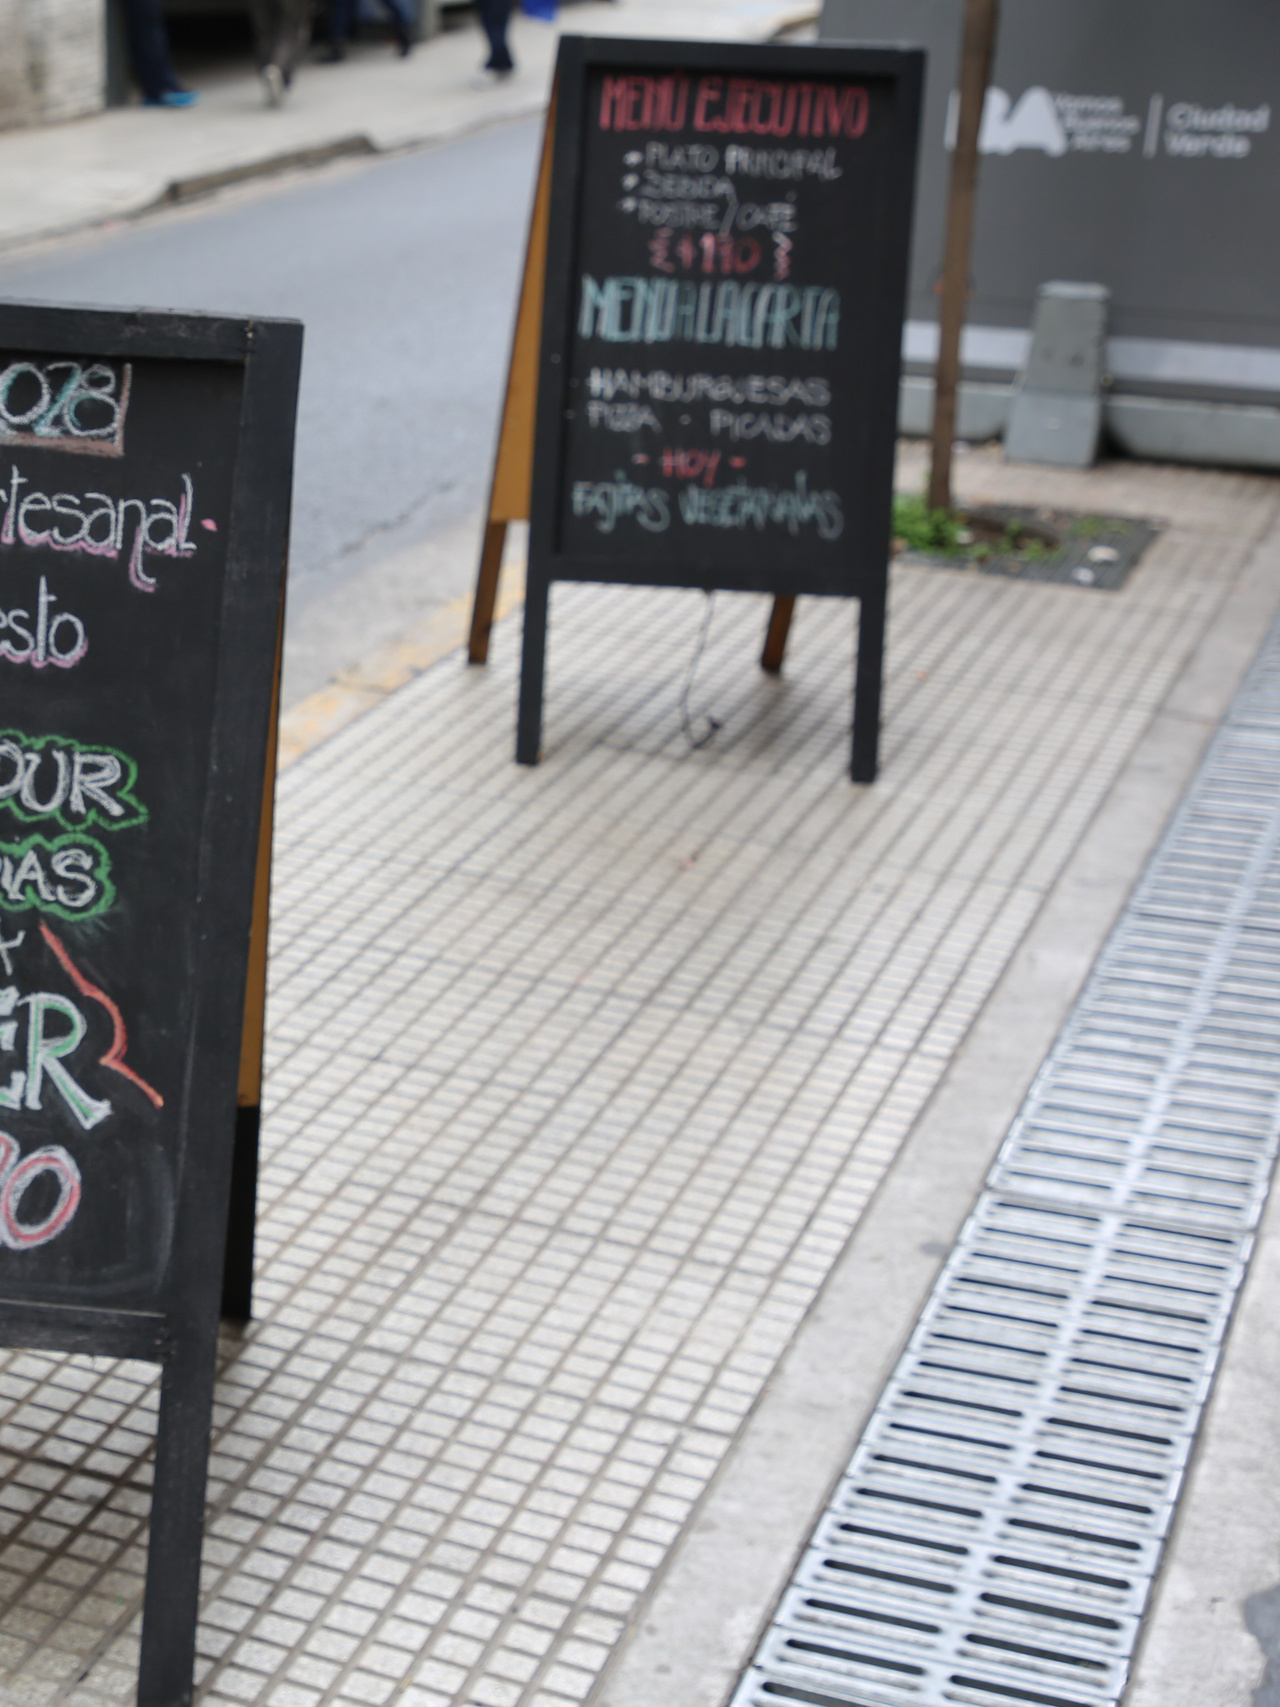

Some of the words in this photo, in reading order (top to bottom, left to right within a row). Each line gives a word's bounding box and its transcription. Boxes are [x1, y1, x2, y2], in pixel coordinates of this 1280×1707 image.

[693, 75, 869, 139] EJECUTIVO
[644, 141, 720, 173] PLATO
[586, 400, 663, 434] PIZZA
[709, 407, 833, 445] PICADAS
[661, 446, 723, 488] HOY
